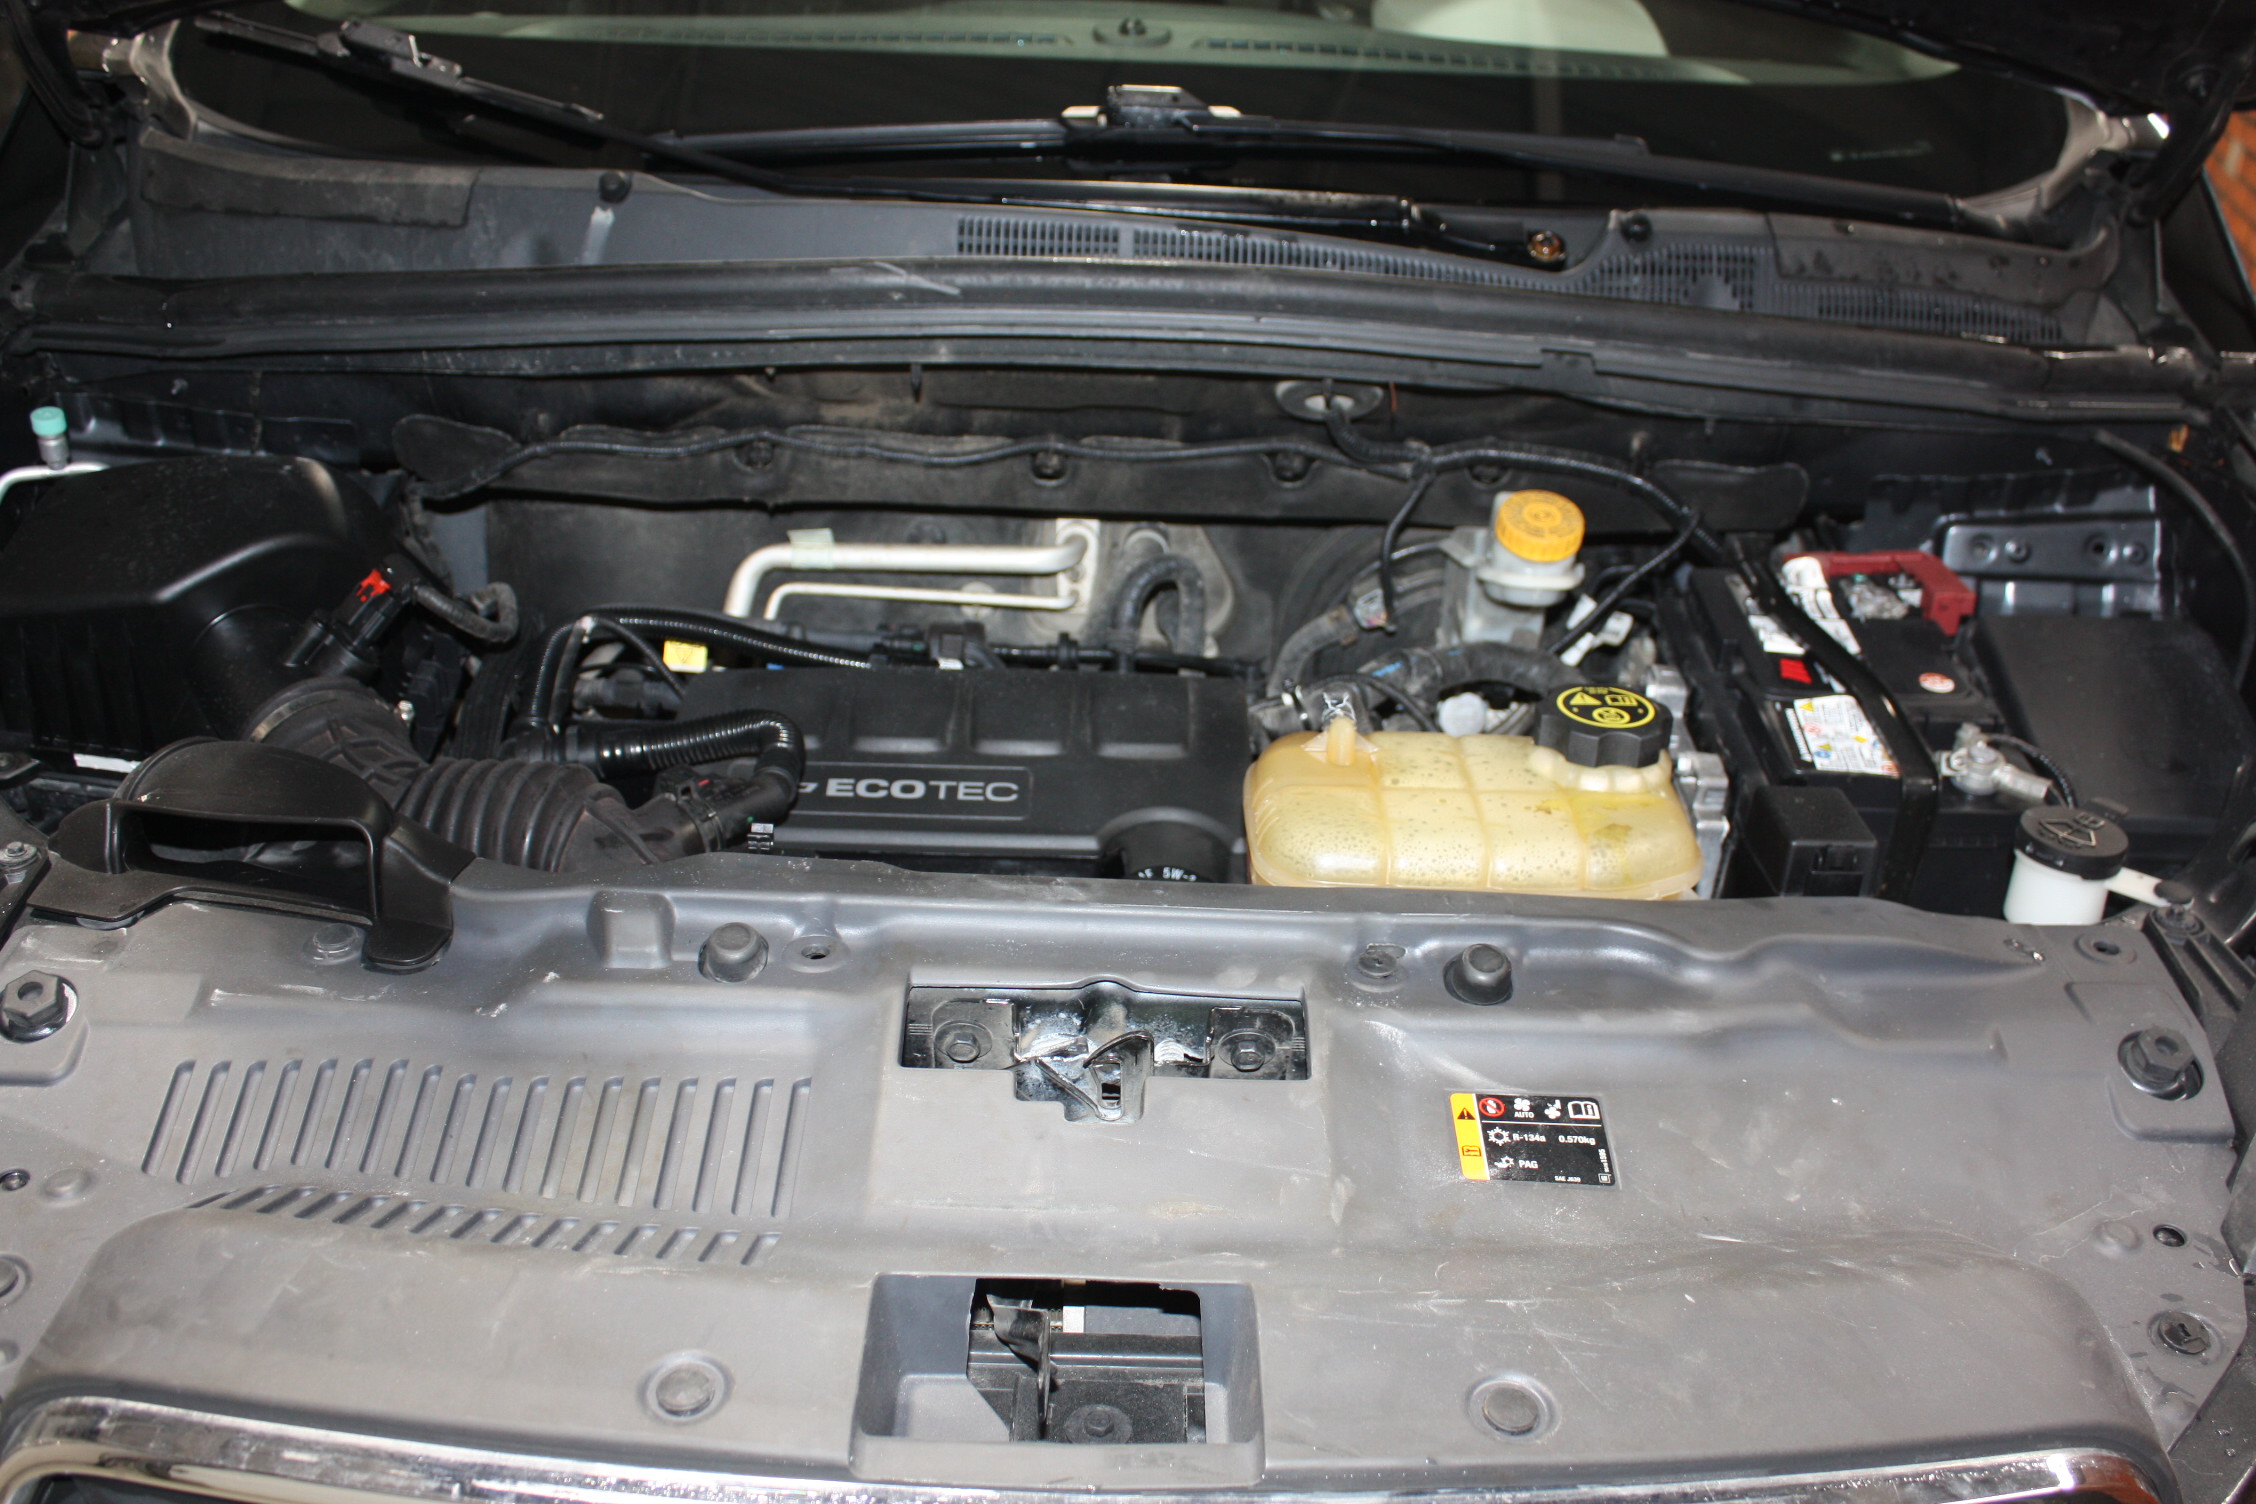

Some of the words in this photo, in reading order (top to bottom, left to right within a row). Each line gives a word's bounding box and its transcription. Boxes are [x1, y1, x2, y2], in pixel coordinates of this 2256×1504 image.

[826, 778, 1019, 802] ECOTEC
[1512, 1133, 1546, 1143] R-134a
[1558, 1135, 1596, 1146] 0.570kg
[1518, 1159, 1539, 1169] PAG
